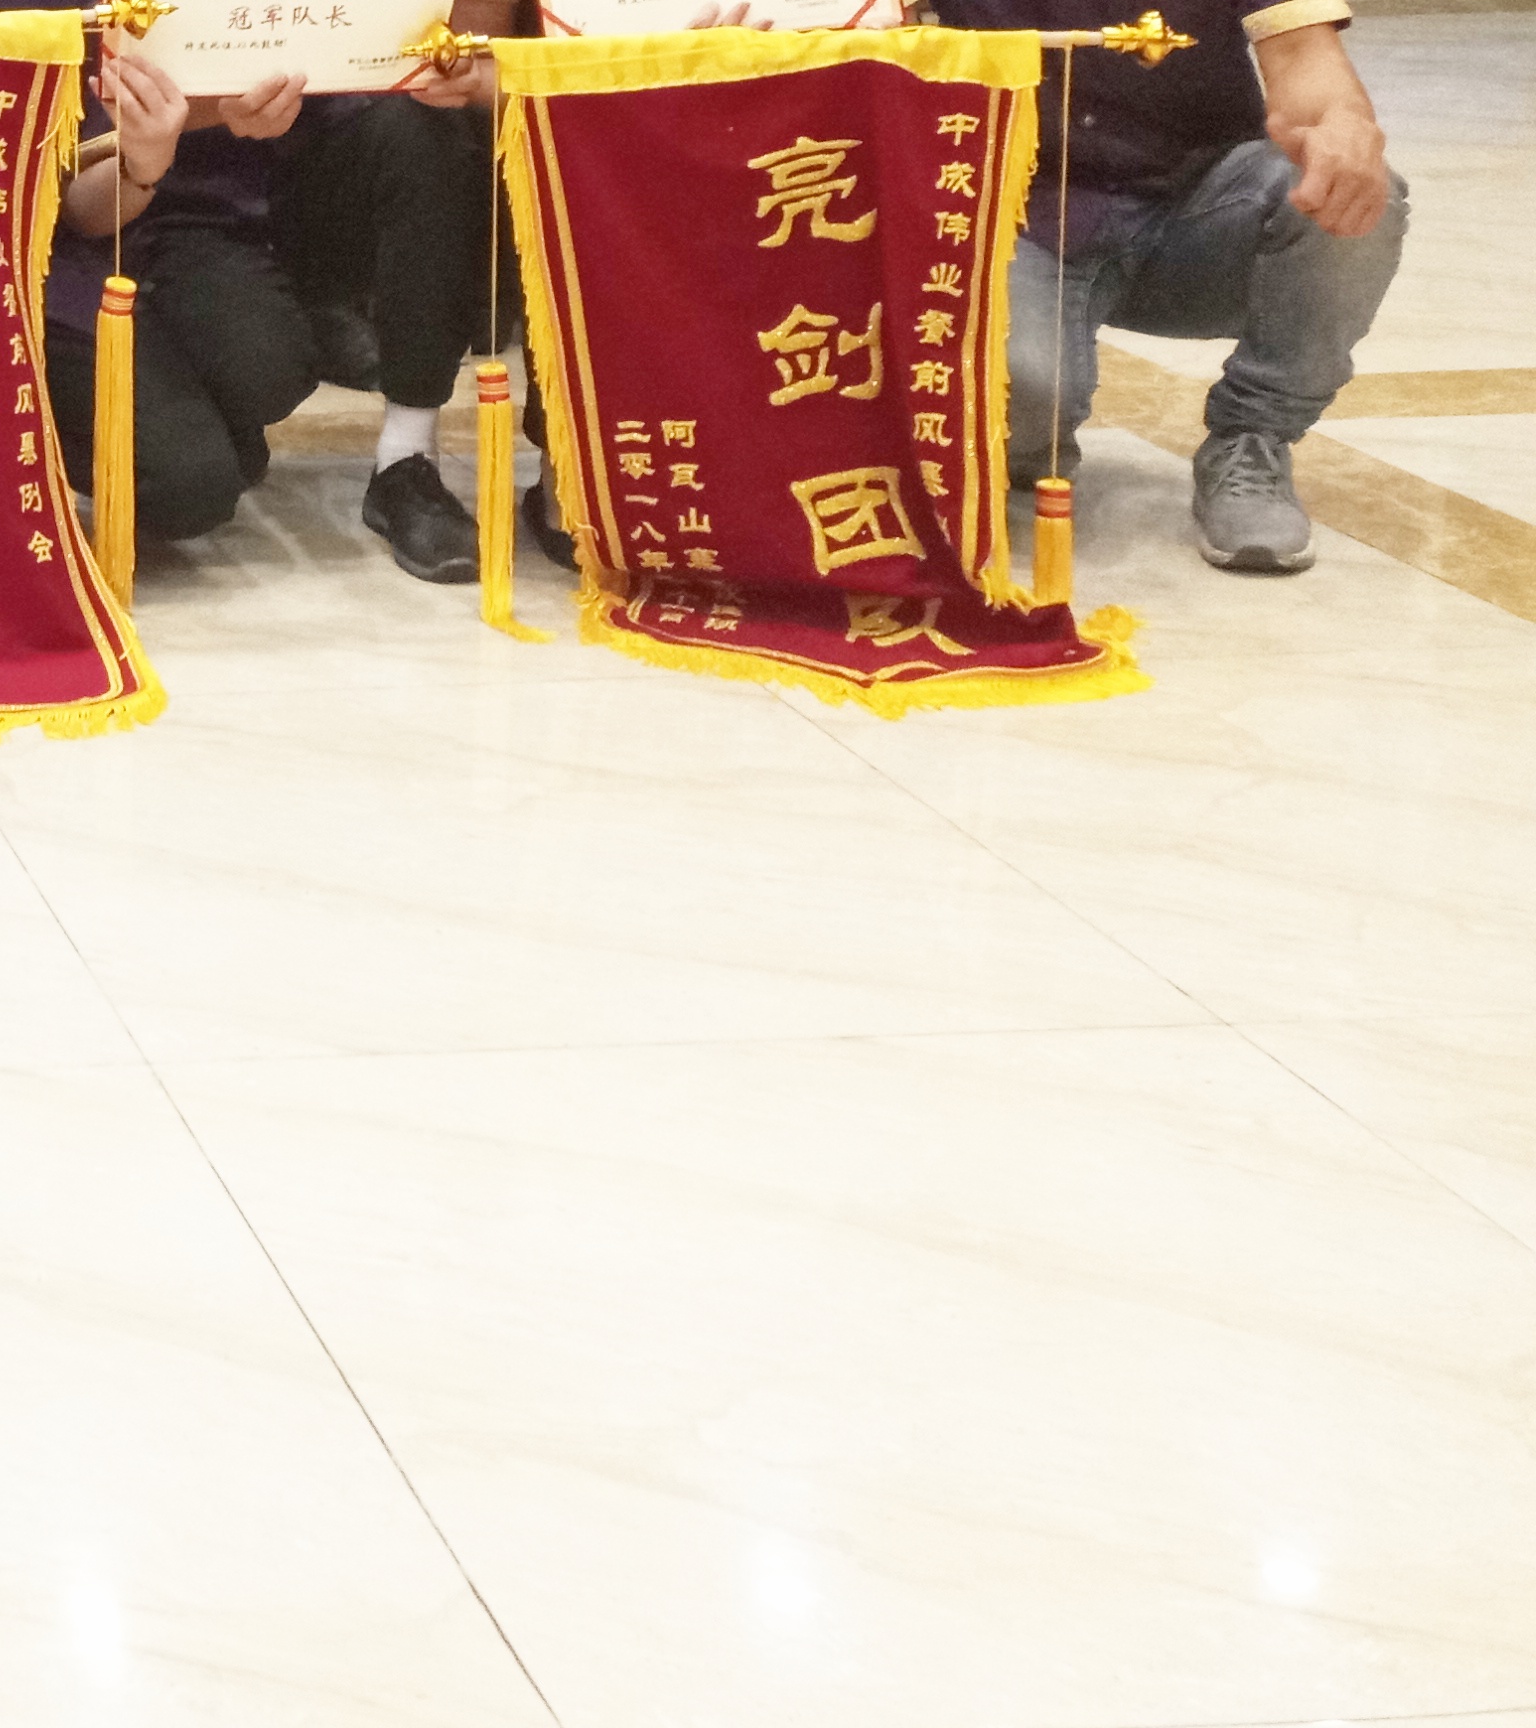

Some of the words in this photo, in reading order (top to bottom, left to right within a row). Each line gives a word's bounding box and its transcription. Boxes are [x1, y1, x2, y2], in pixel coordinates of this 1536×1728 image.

[227, 4, 353, 32] 冠军队长
[747, 135, 978, 657] 亮剑团队
